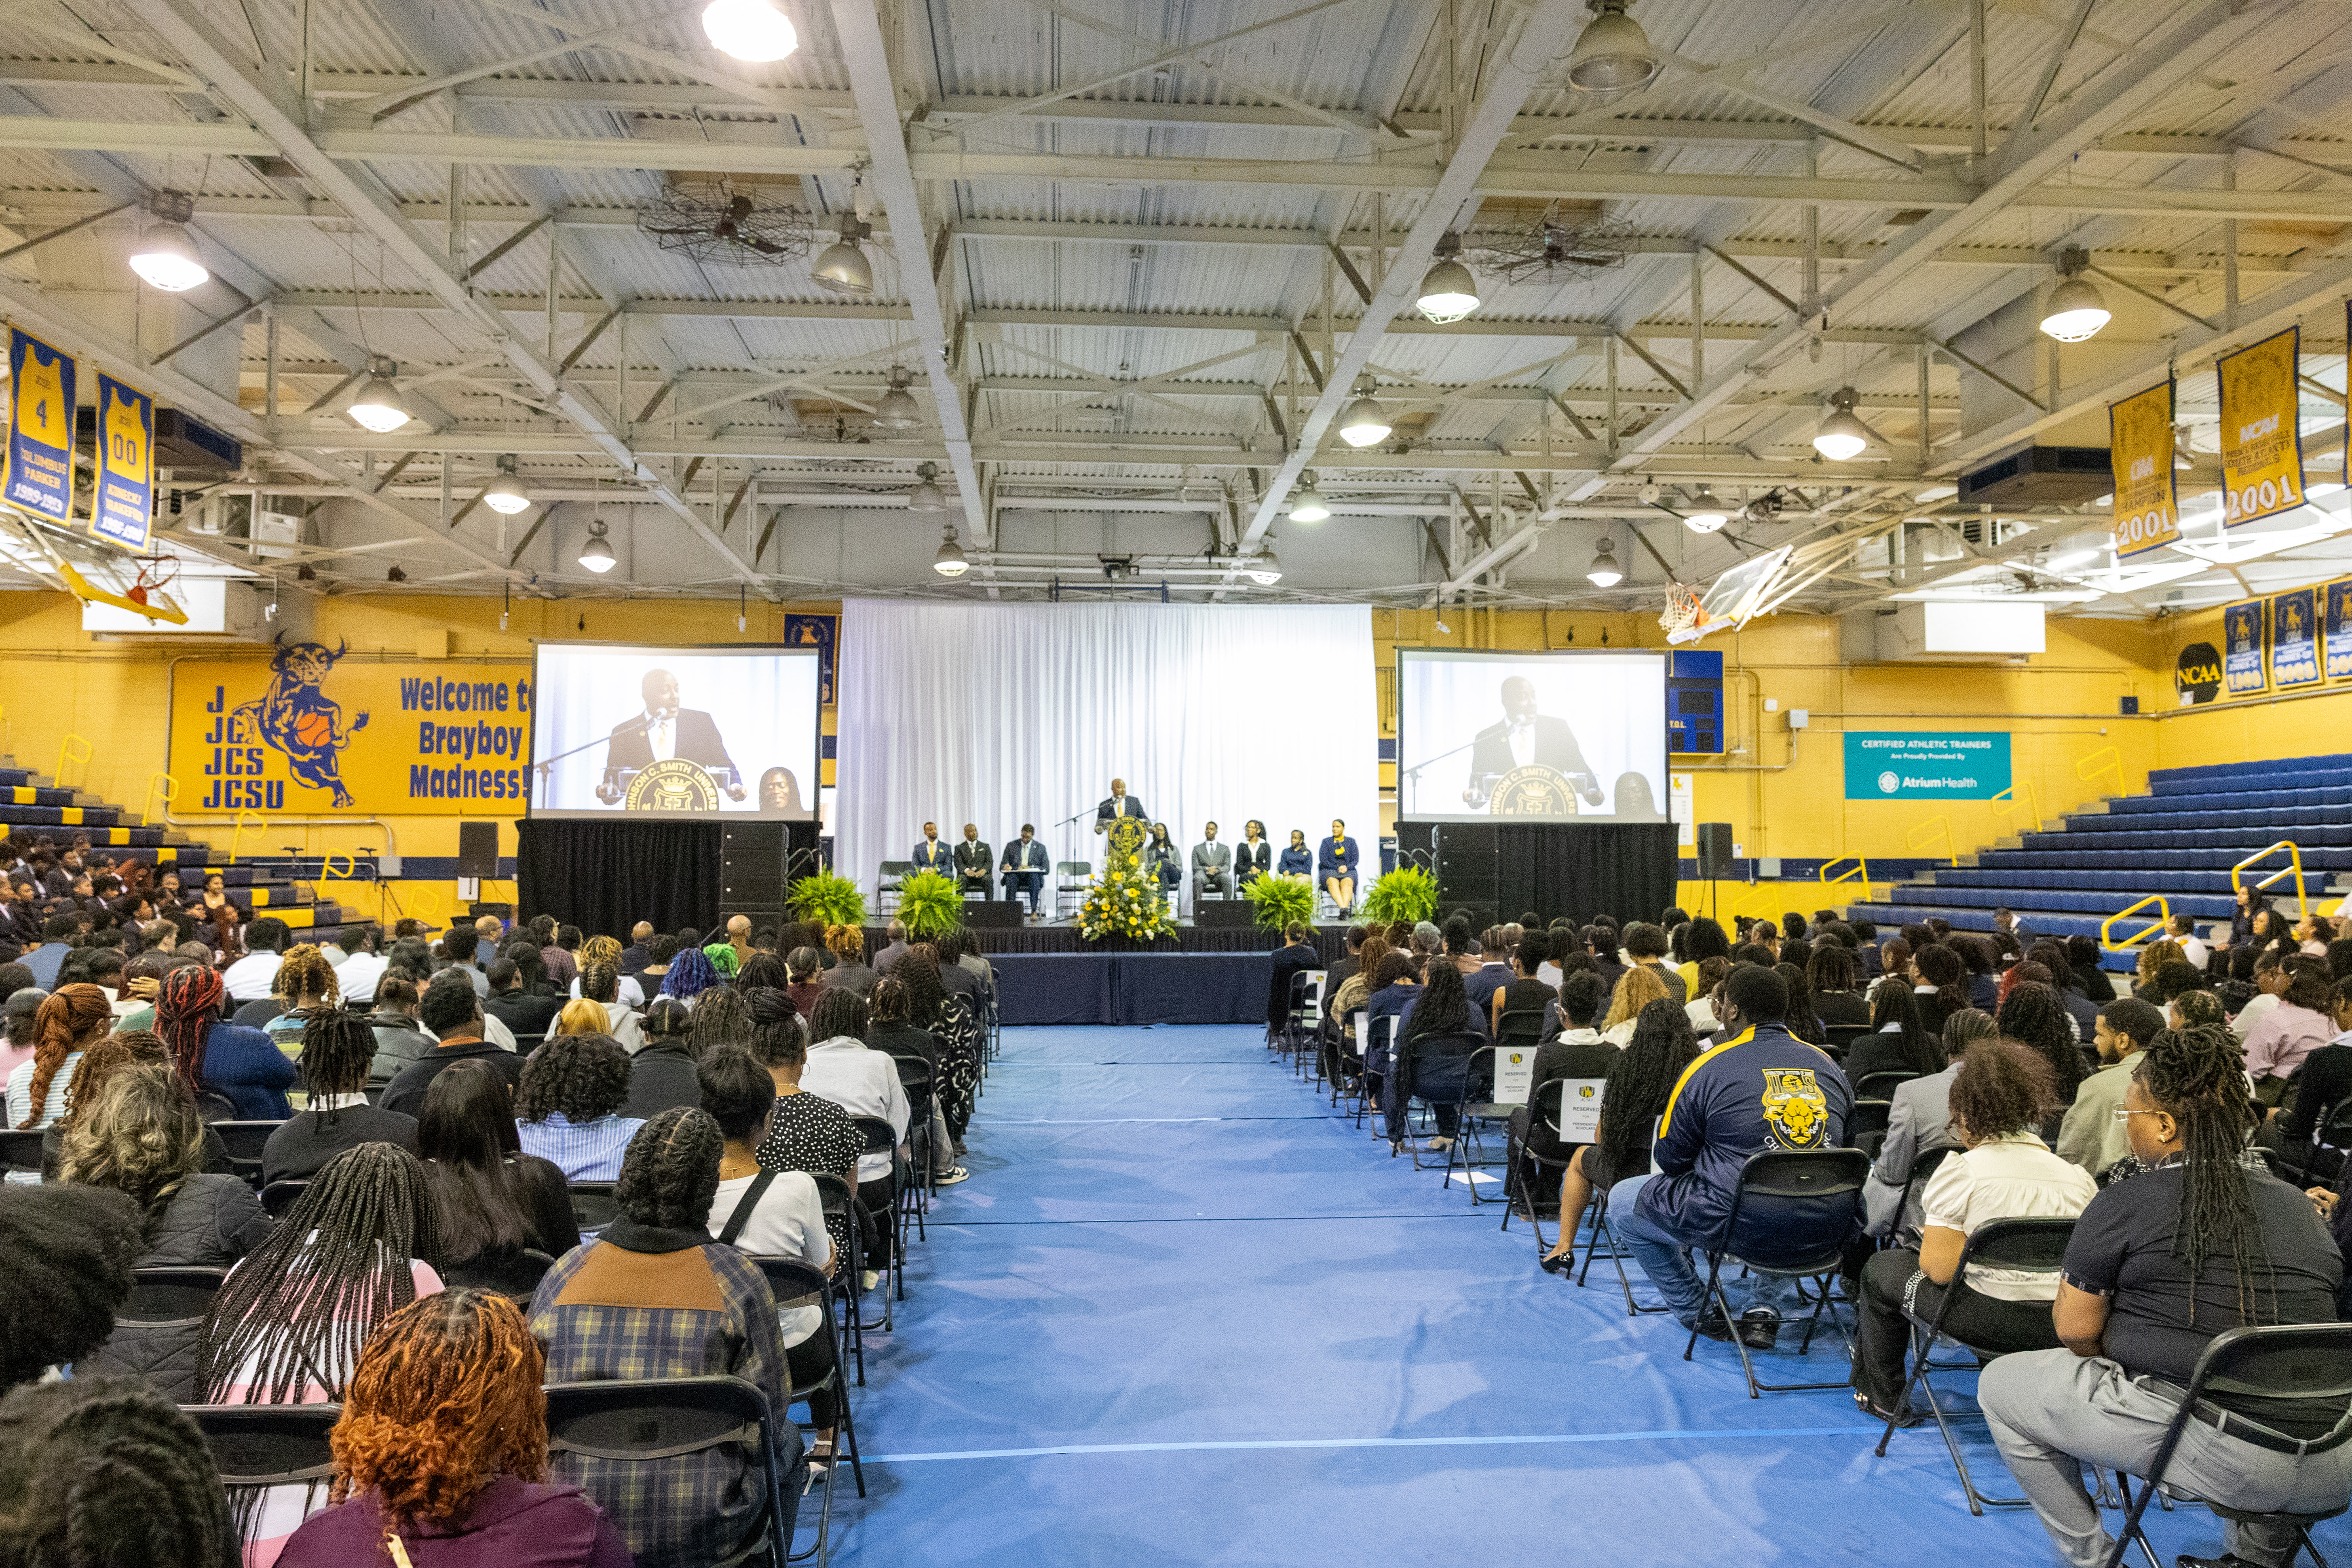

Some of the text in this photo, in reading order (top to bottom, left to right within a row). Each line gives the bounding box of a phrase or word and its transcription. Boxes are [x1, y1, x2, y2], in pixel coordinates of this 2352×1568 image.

[36, 399, 47, 428] 4
[113, 433, 137, 466] 00
[24, 466, 61, 489] PARKER
[2229, 473, 2297, 519] 2001
[2119, 508, 2175, 546] 2001
[2179, 663, 2221, 686] NCAA
[207, 686, 224, 713] J
[401, 676, 508, 711] Welcome
[420, 721, 522, 760] Brayboy
[1861, 740, 1992, 749] CERTIFIED ATHLETIC TRAINERS
[205, 748, 264, 775] JCS
[203, 780, 284, 808] JCSU
[410, 764, 528, 798] Madness!
[648, 767, 660, 777] C.
[660, 762, 693, 774] SMITH
[694, 770, 718, 810] UNIVERS
[1510, 772, 1522, 781] C.
[1521, 767, 1552, 779] SMITH
[1553, 775, 1576, 814] UNIVERS
[1902, 777, 1978, 788] Atrium Health
[1823, 1132, 1832, 1148] NC
